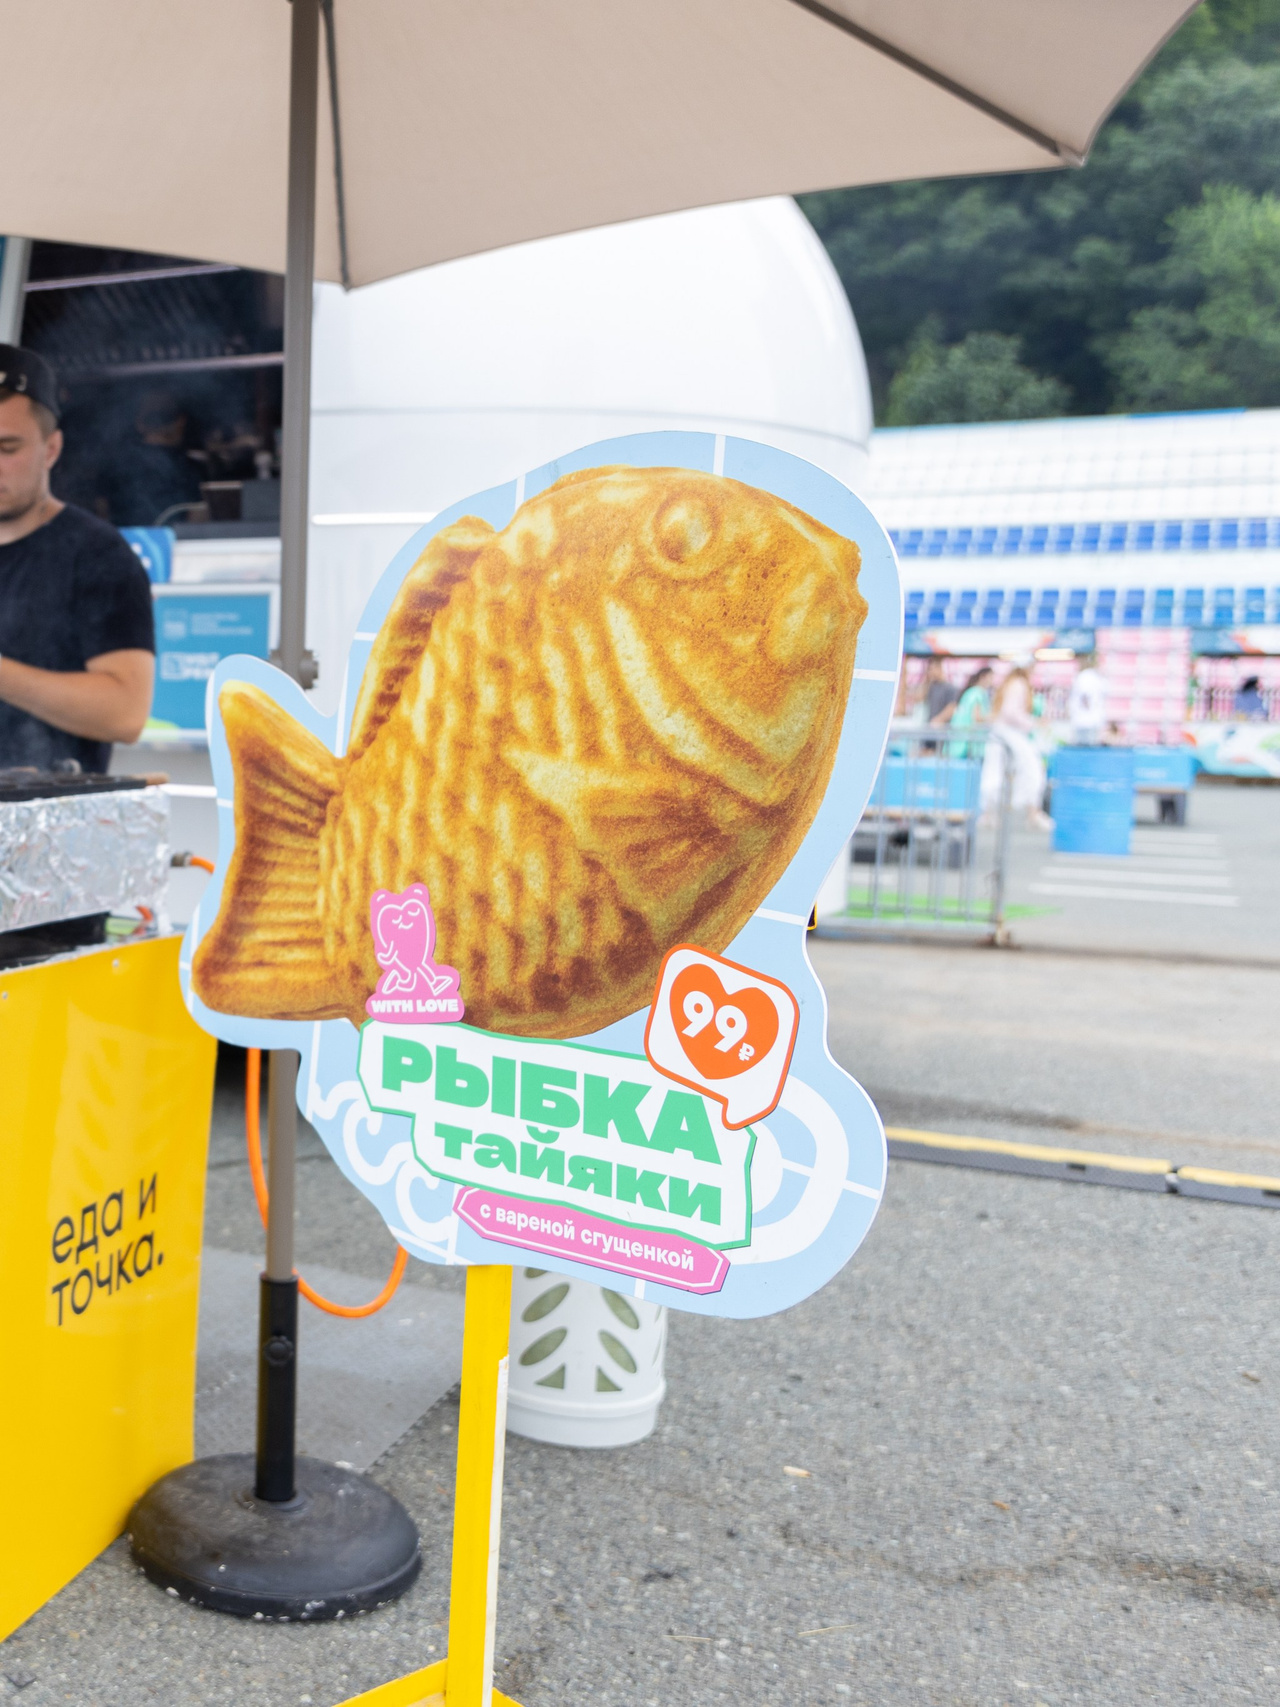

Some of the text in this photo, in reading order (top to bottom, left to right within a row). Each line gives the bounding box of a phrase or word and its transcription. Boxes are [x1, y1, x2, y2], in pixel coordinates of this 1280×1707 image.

[370, 998, 459, 1013] WITH LOVE
[381, 1034, 723, 1166] РЫБКА
[51, 1171, 158, 1265] еда и
[433, 1120, 722, 1226] тайяки
[51, 1229, 165, 1327] точка.
[479, 1203, 695, 1272] с вареной сгущенкой
